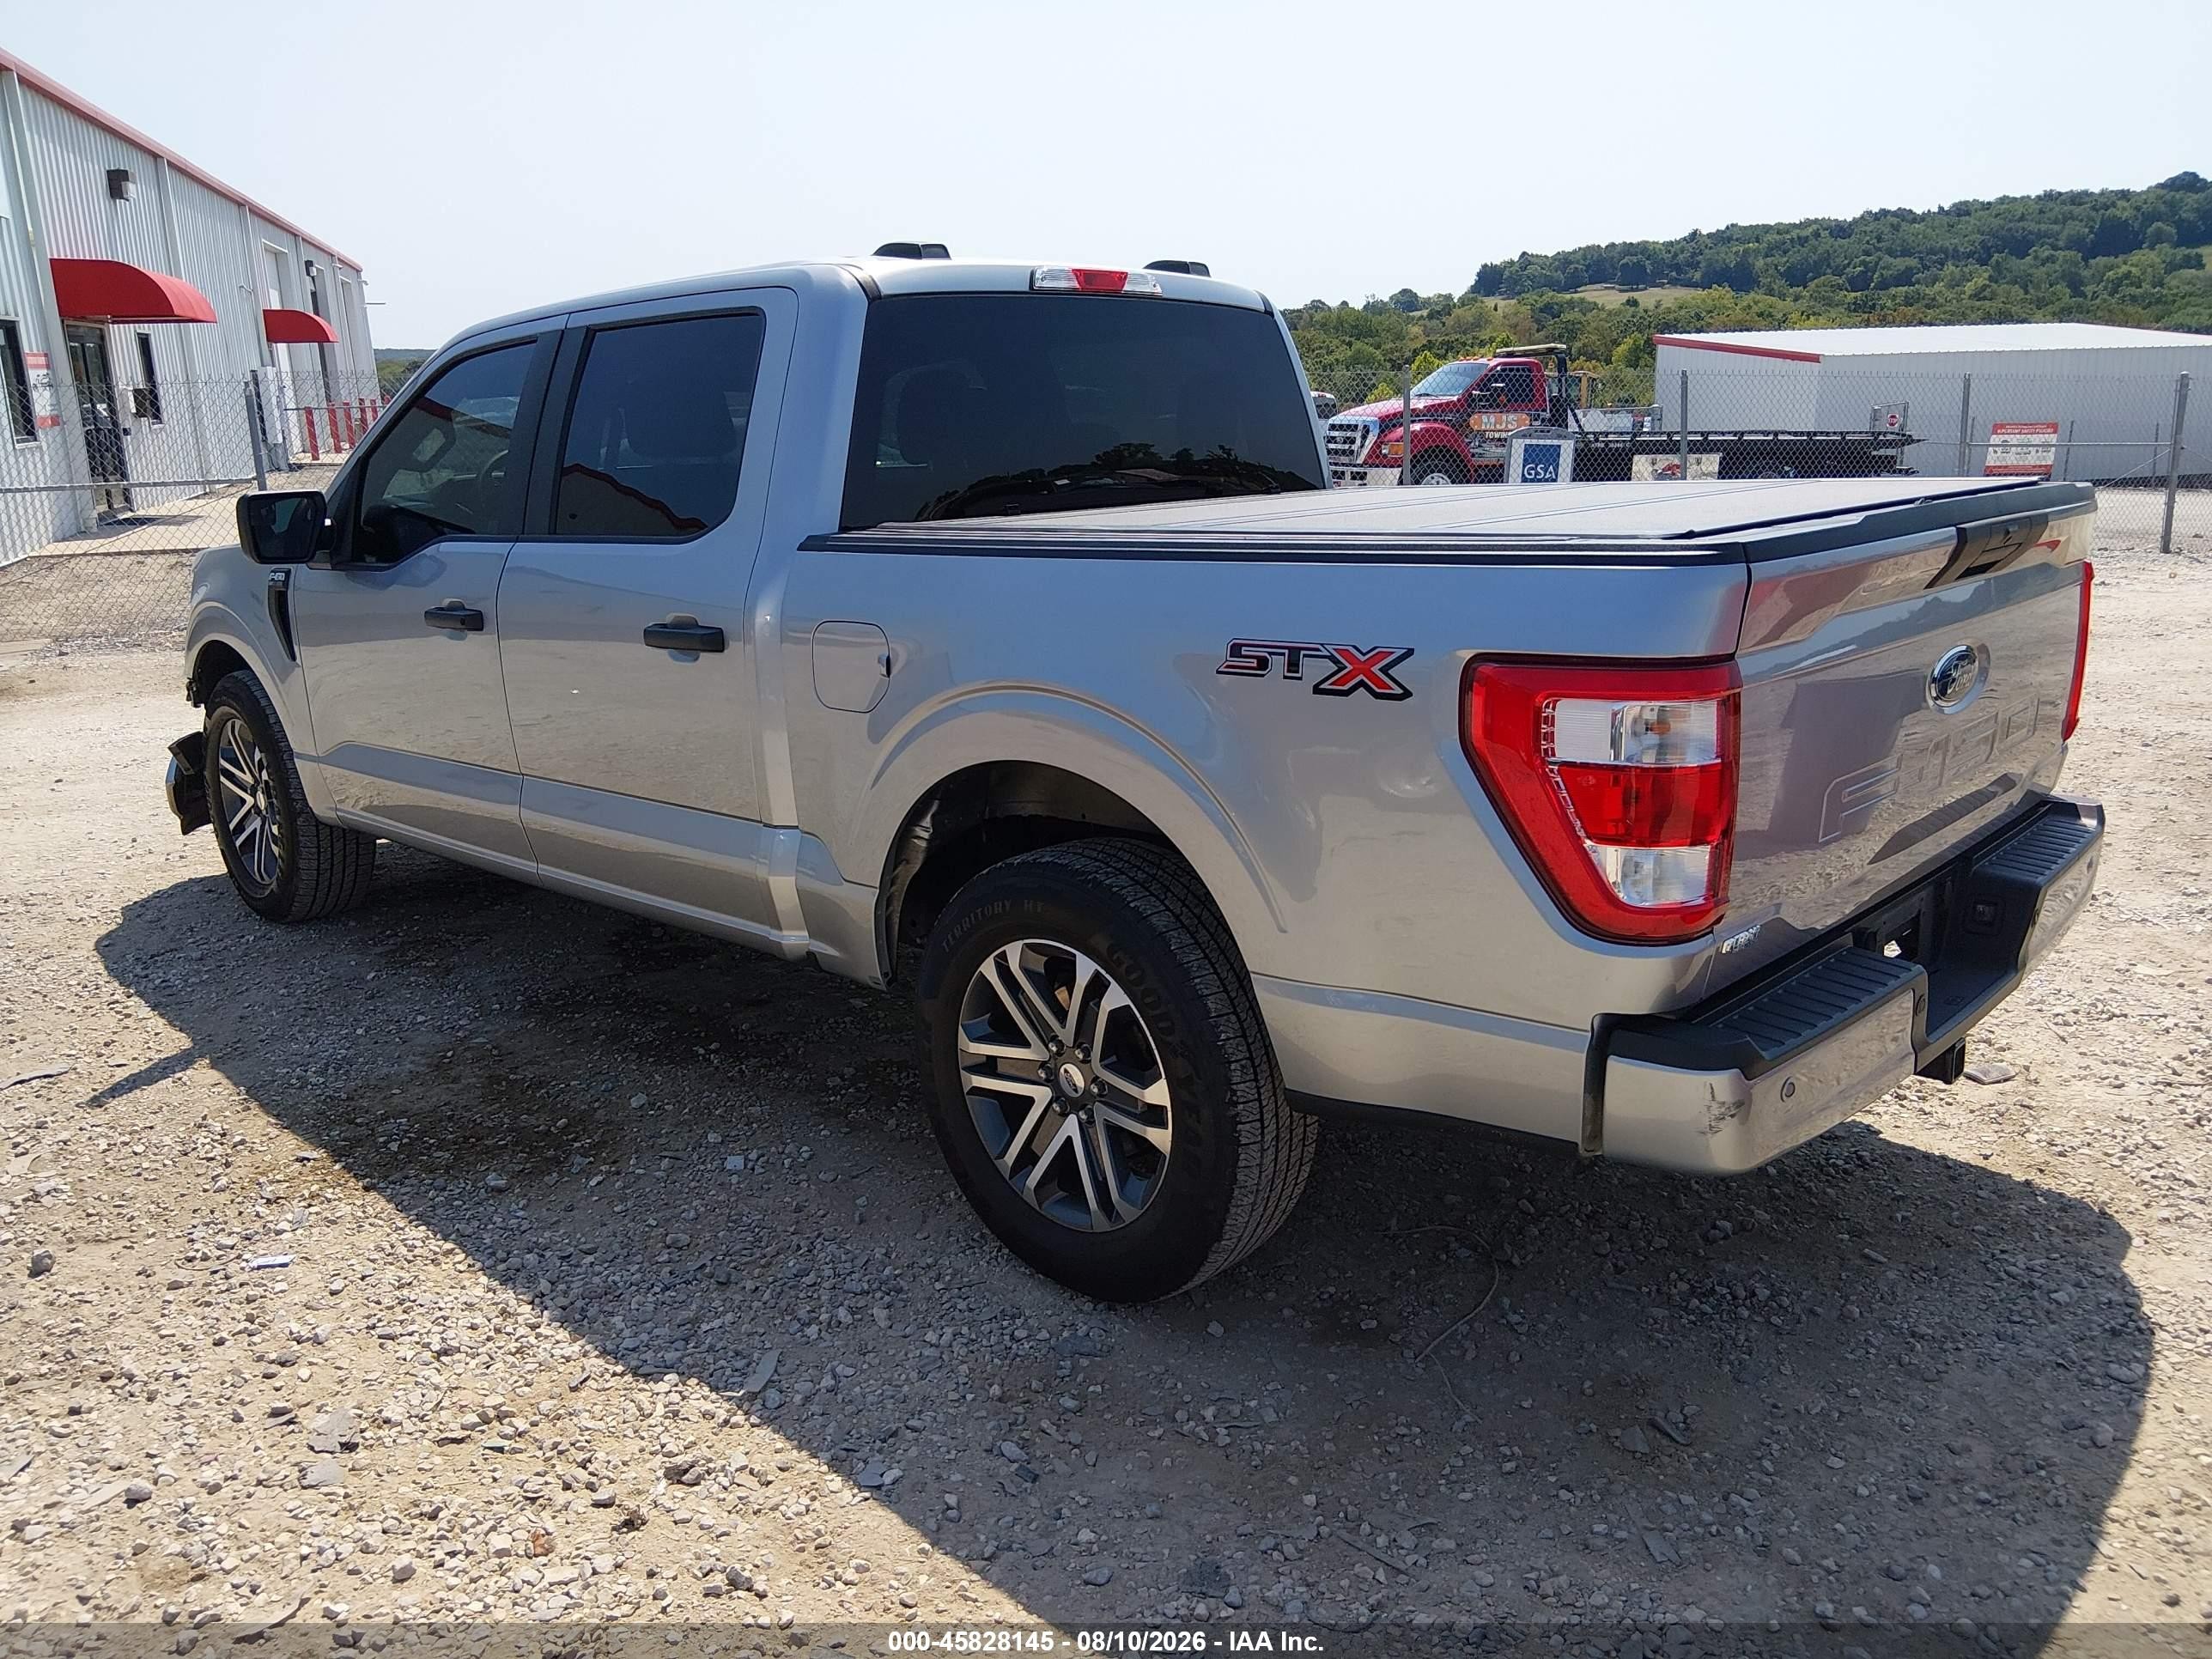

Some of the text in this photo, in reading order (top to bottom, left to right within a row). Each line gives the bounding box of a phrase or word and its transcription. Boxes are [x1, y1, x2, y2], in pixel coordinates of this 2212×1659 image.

[1481, 415, 1518, 429] MJS
[1524, 464, 1556, 479] GSA
[1215, 638, 1415, 702] STX
[941, 898, 1045, 953] TERRITORY HT
